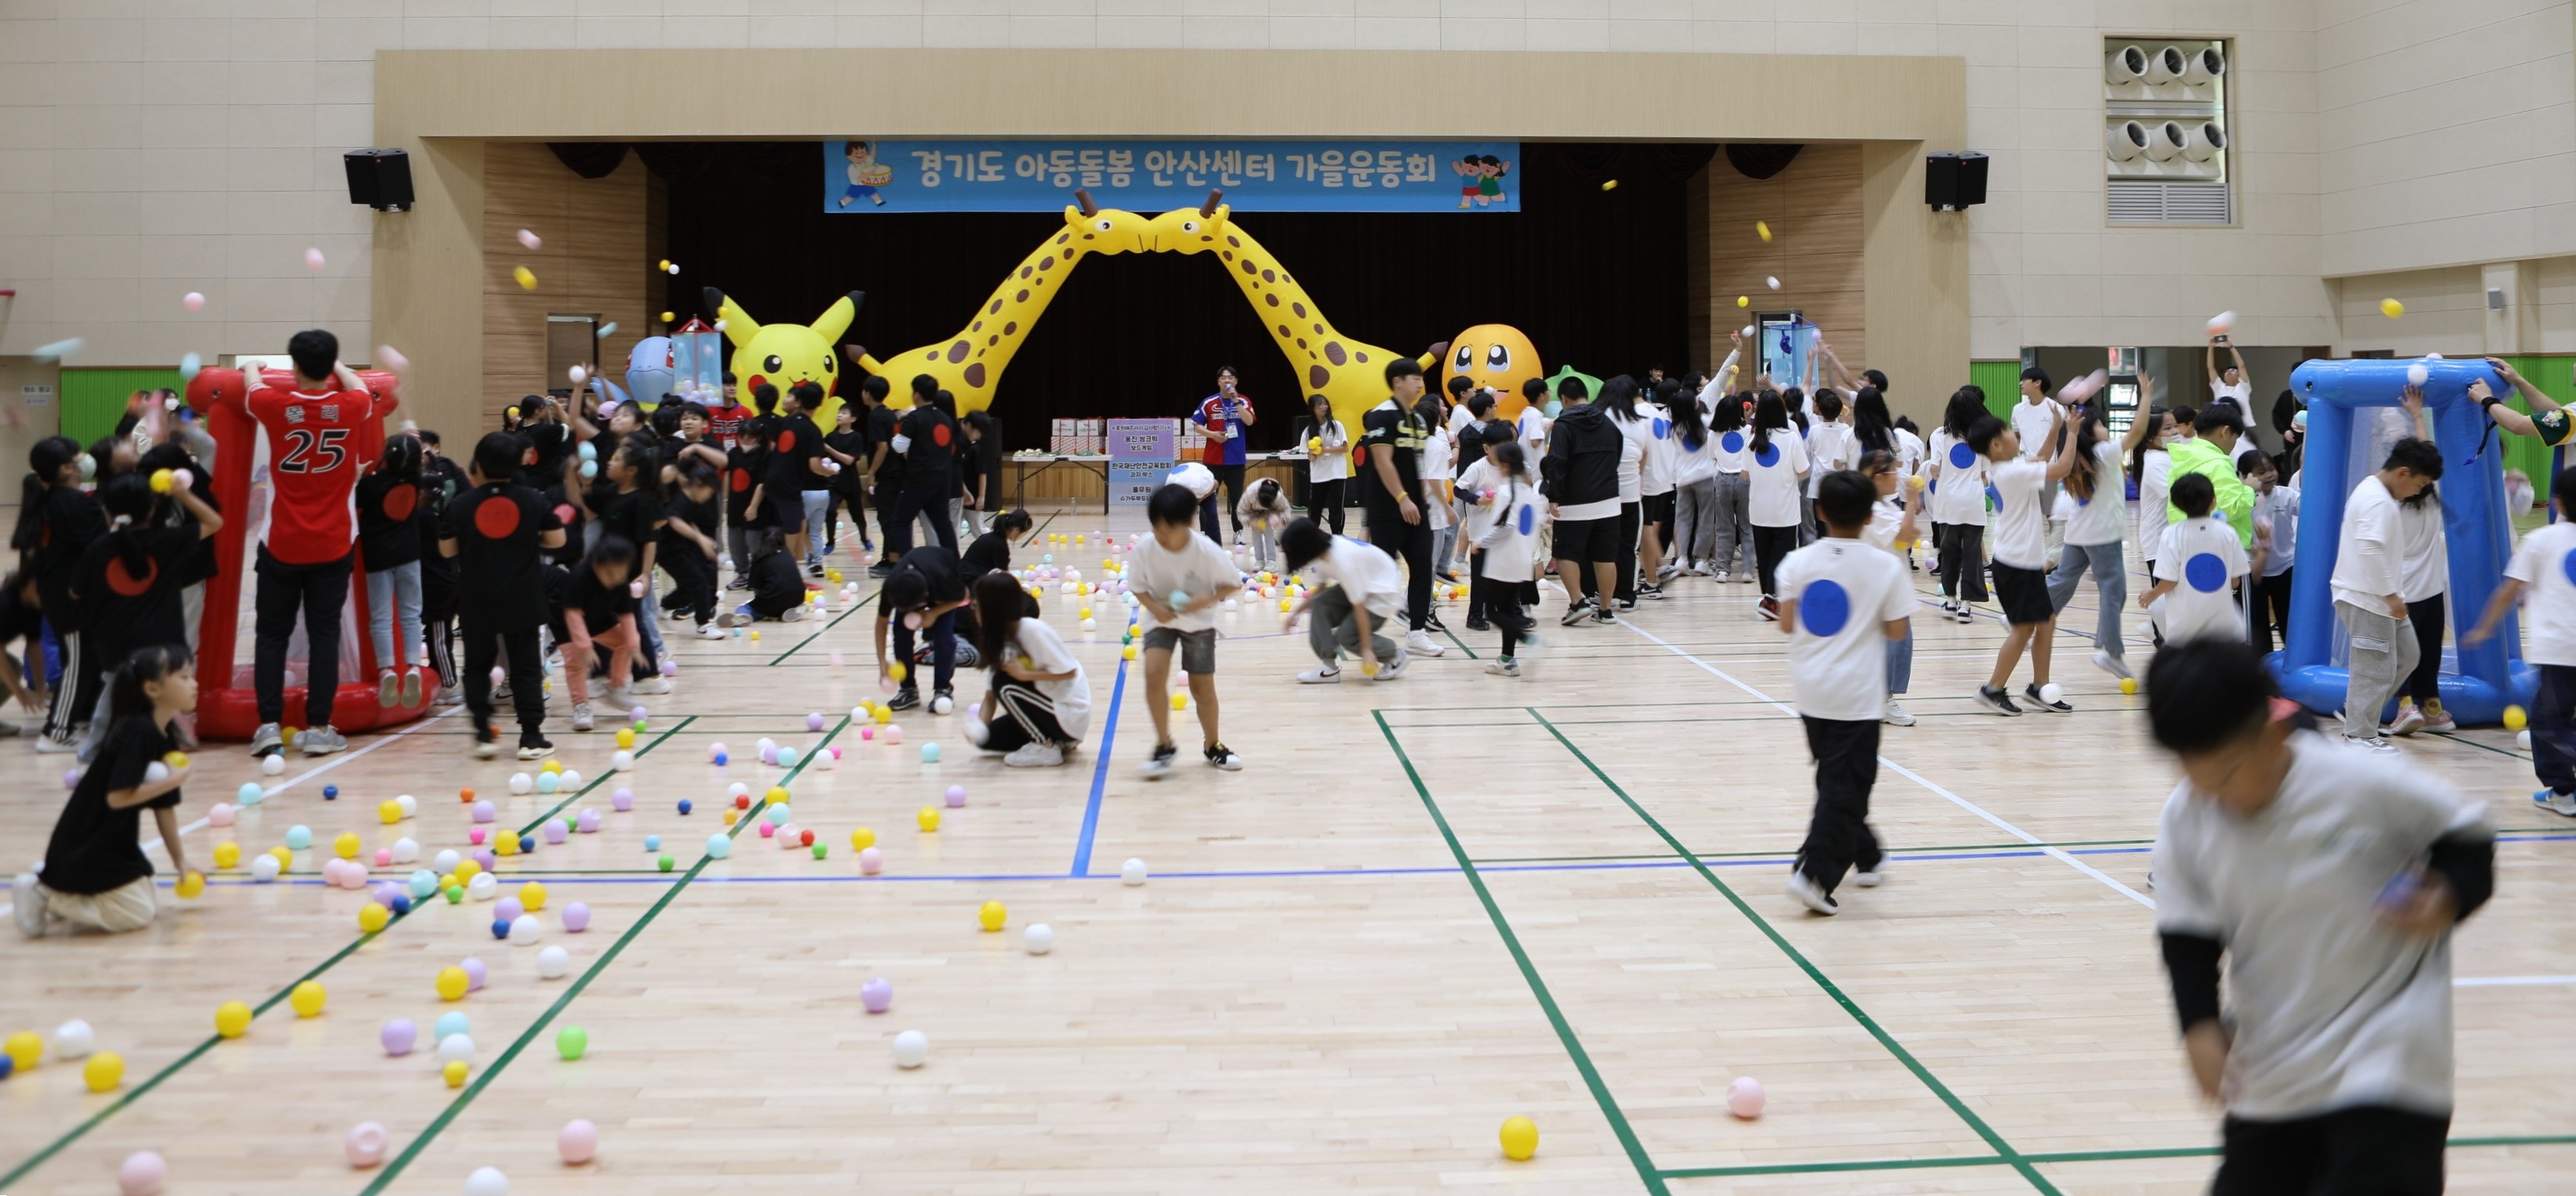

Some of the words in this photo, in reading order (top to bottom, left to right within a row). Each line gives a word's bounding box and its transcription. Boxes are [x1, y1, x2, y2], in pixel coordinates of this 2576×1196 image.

[912, 150, 1006, 187] 경기도
[1015, 150, 1136, 187] 아동돌봄
[1144, 150, 1274, 187] 안산센터
[1286, 150, 1436, 188] 가을운동회
[280, 428, 351, 474] 25
